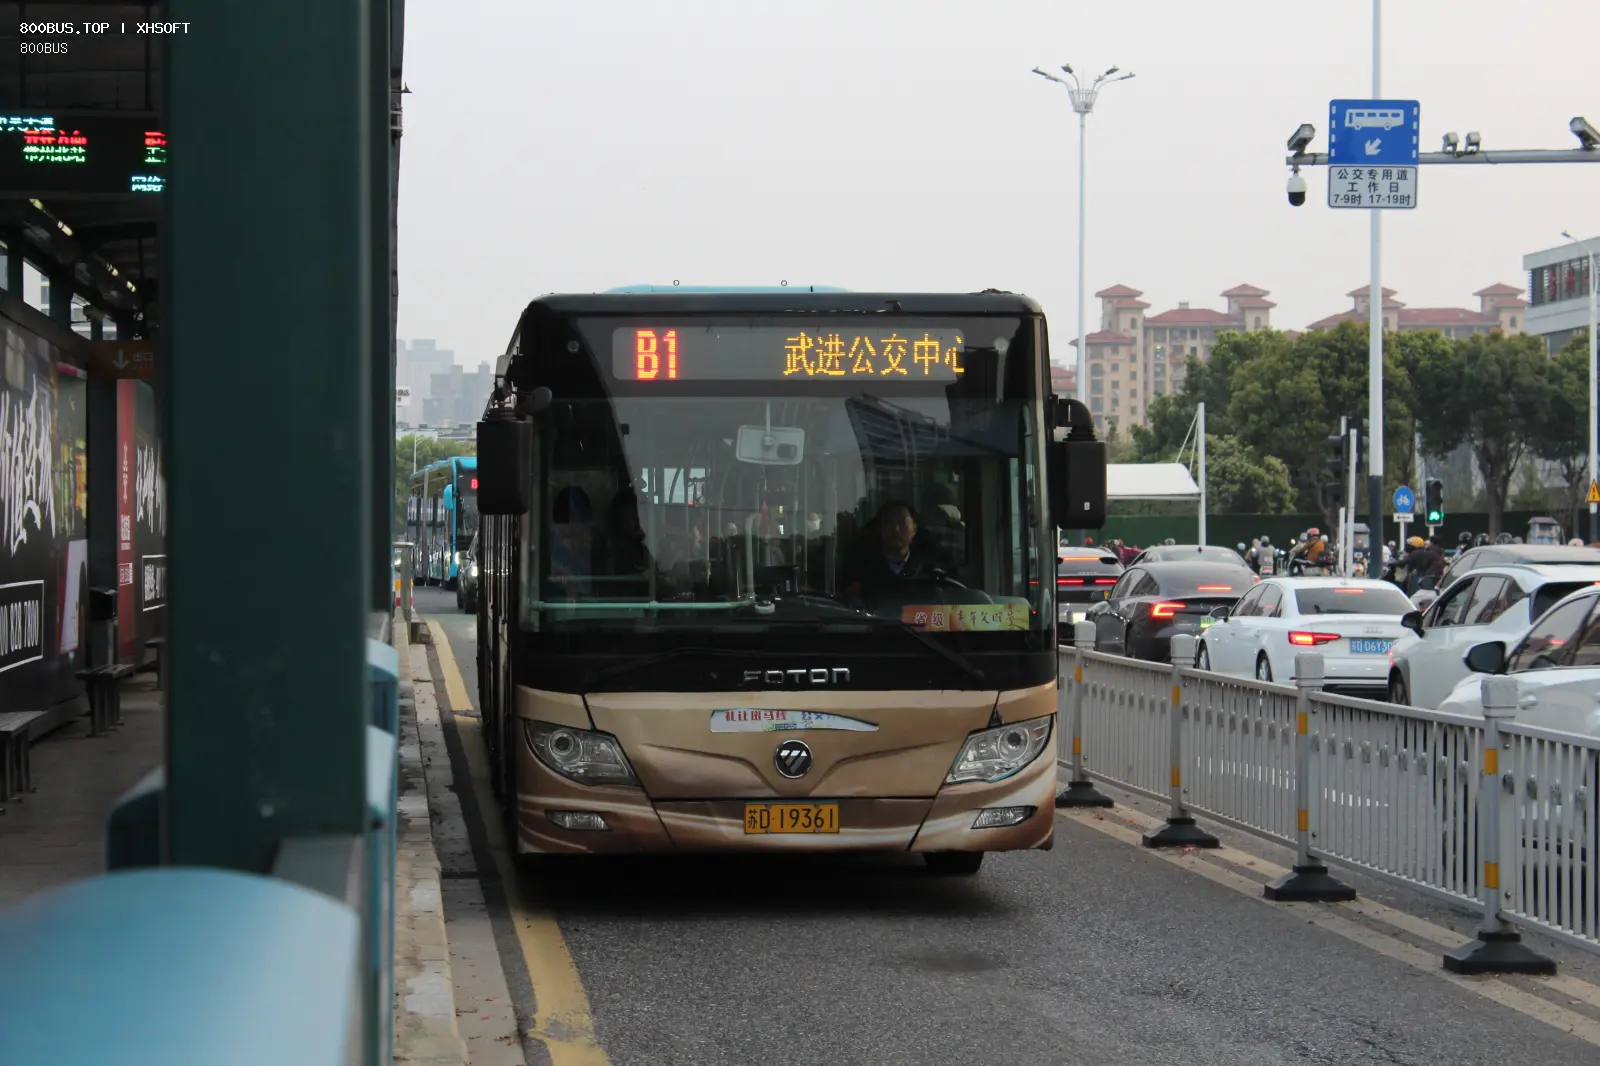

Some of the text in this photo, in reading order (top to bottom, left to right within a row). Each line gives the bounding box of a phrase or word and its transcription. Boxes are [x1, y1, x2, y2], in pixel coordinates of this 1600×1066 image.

[1337, 168, 1408, 180] 公交专用道
[1347, 182, 1399, 193] 工作日
[1333, 194, 1411, 206] 7-9时 17-19时
[635, 329, 677, 380] B1
[10, 601, 22, 653] 828
[742, 667, 850, 685] FOTON
